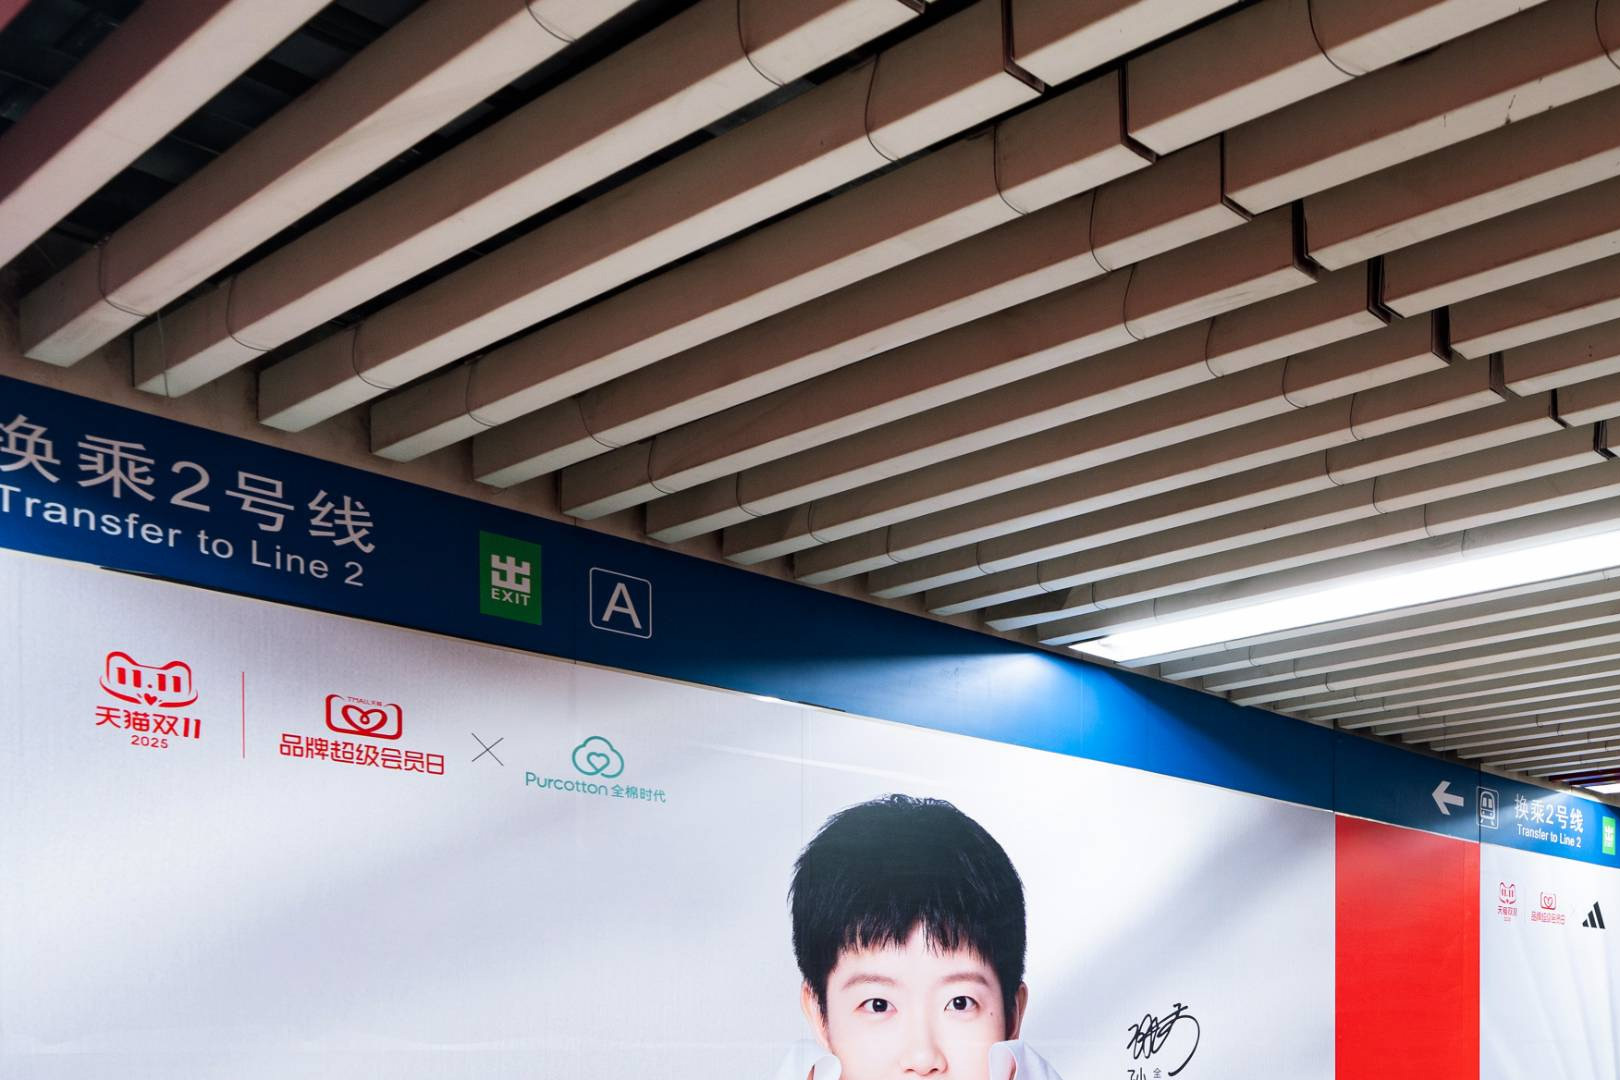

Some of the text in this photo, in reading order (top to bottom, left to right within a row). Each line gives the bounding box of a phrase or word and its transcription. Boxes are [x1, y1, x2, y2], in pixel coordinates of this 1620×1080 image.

[0, 414, 376, 556] 换乘2号线
[0, 483, 365, 588] Transfer to Line 2
[491, 586, 531, 607] EXIT
[601, 581, 642, 630] A
[115, 666, 183, 694] 11.11
[95, 705, 202, 740] 天猫双11
[130, 734, 170, 750] 2025
[278, 733, 446, 776] 品牌超级会员日
[525, 771, 667, 804] Purcotton 全棉时代
[1514, 793, 1584, 834] 换乘2号线
[1517, 823, 1582, 849] Transfer to Line 2
